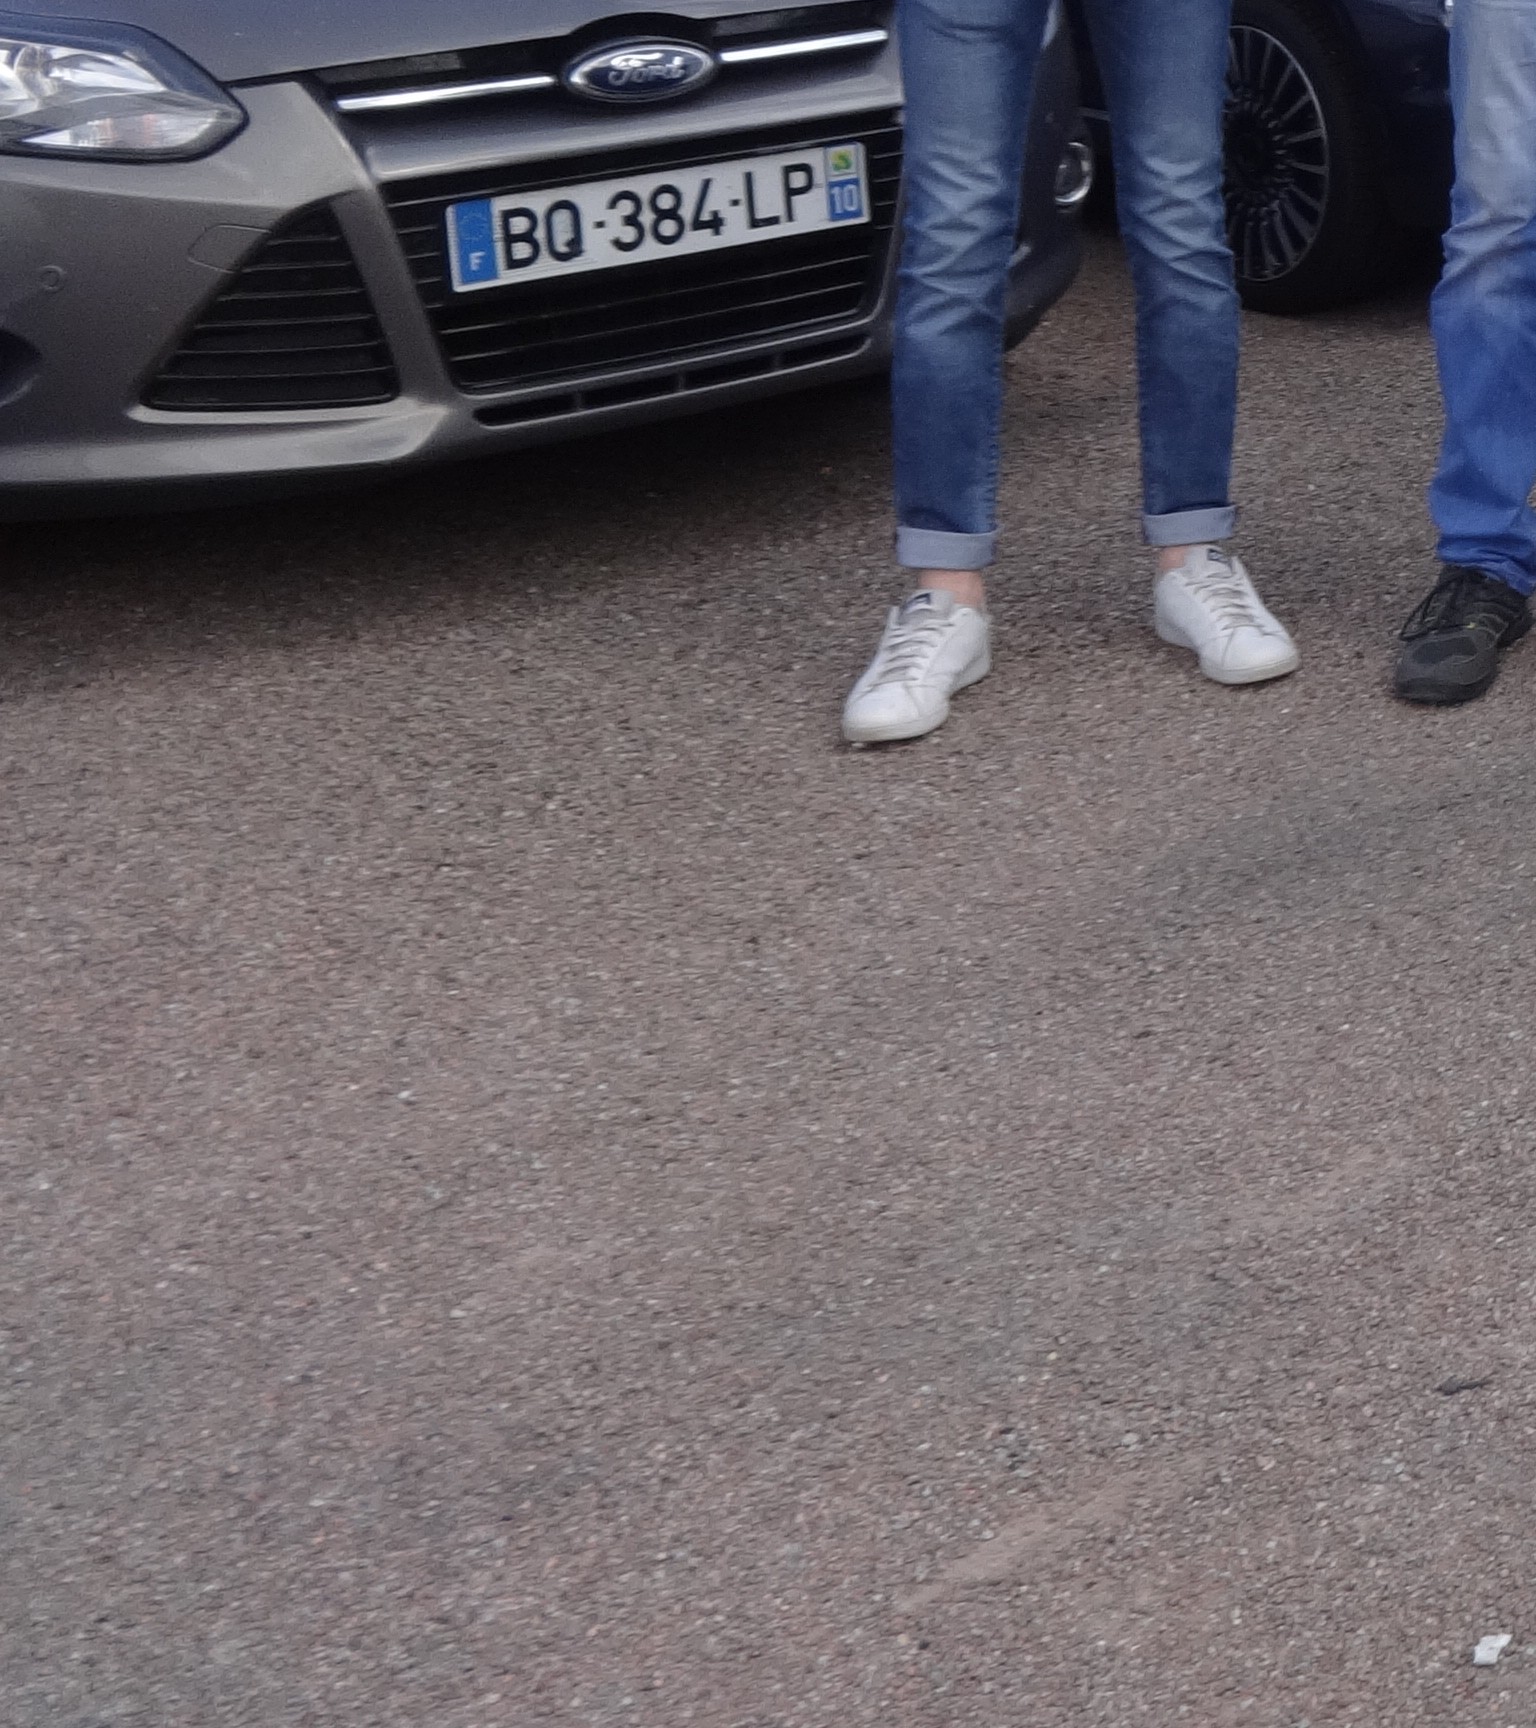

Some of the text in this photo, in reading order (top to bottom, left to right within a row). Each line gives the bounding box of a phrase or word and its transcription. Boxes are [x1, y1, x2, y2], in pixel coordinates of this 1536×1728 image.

[608, 52, 685, 86] Ford
[469, 162, 814, 271] F BQ-384-LP
[831, 184, 859, 216] 10
